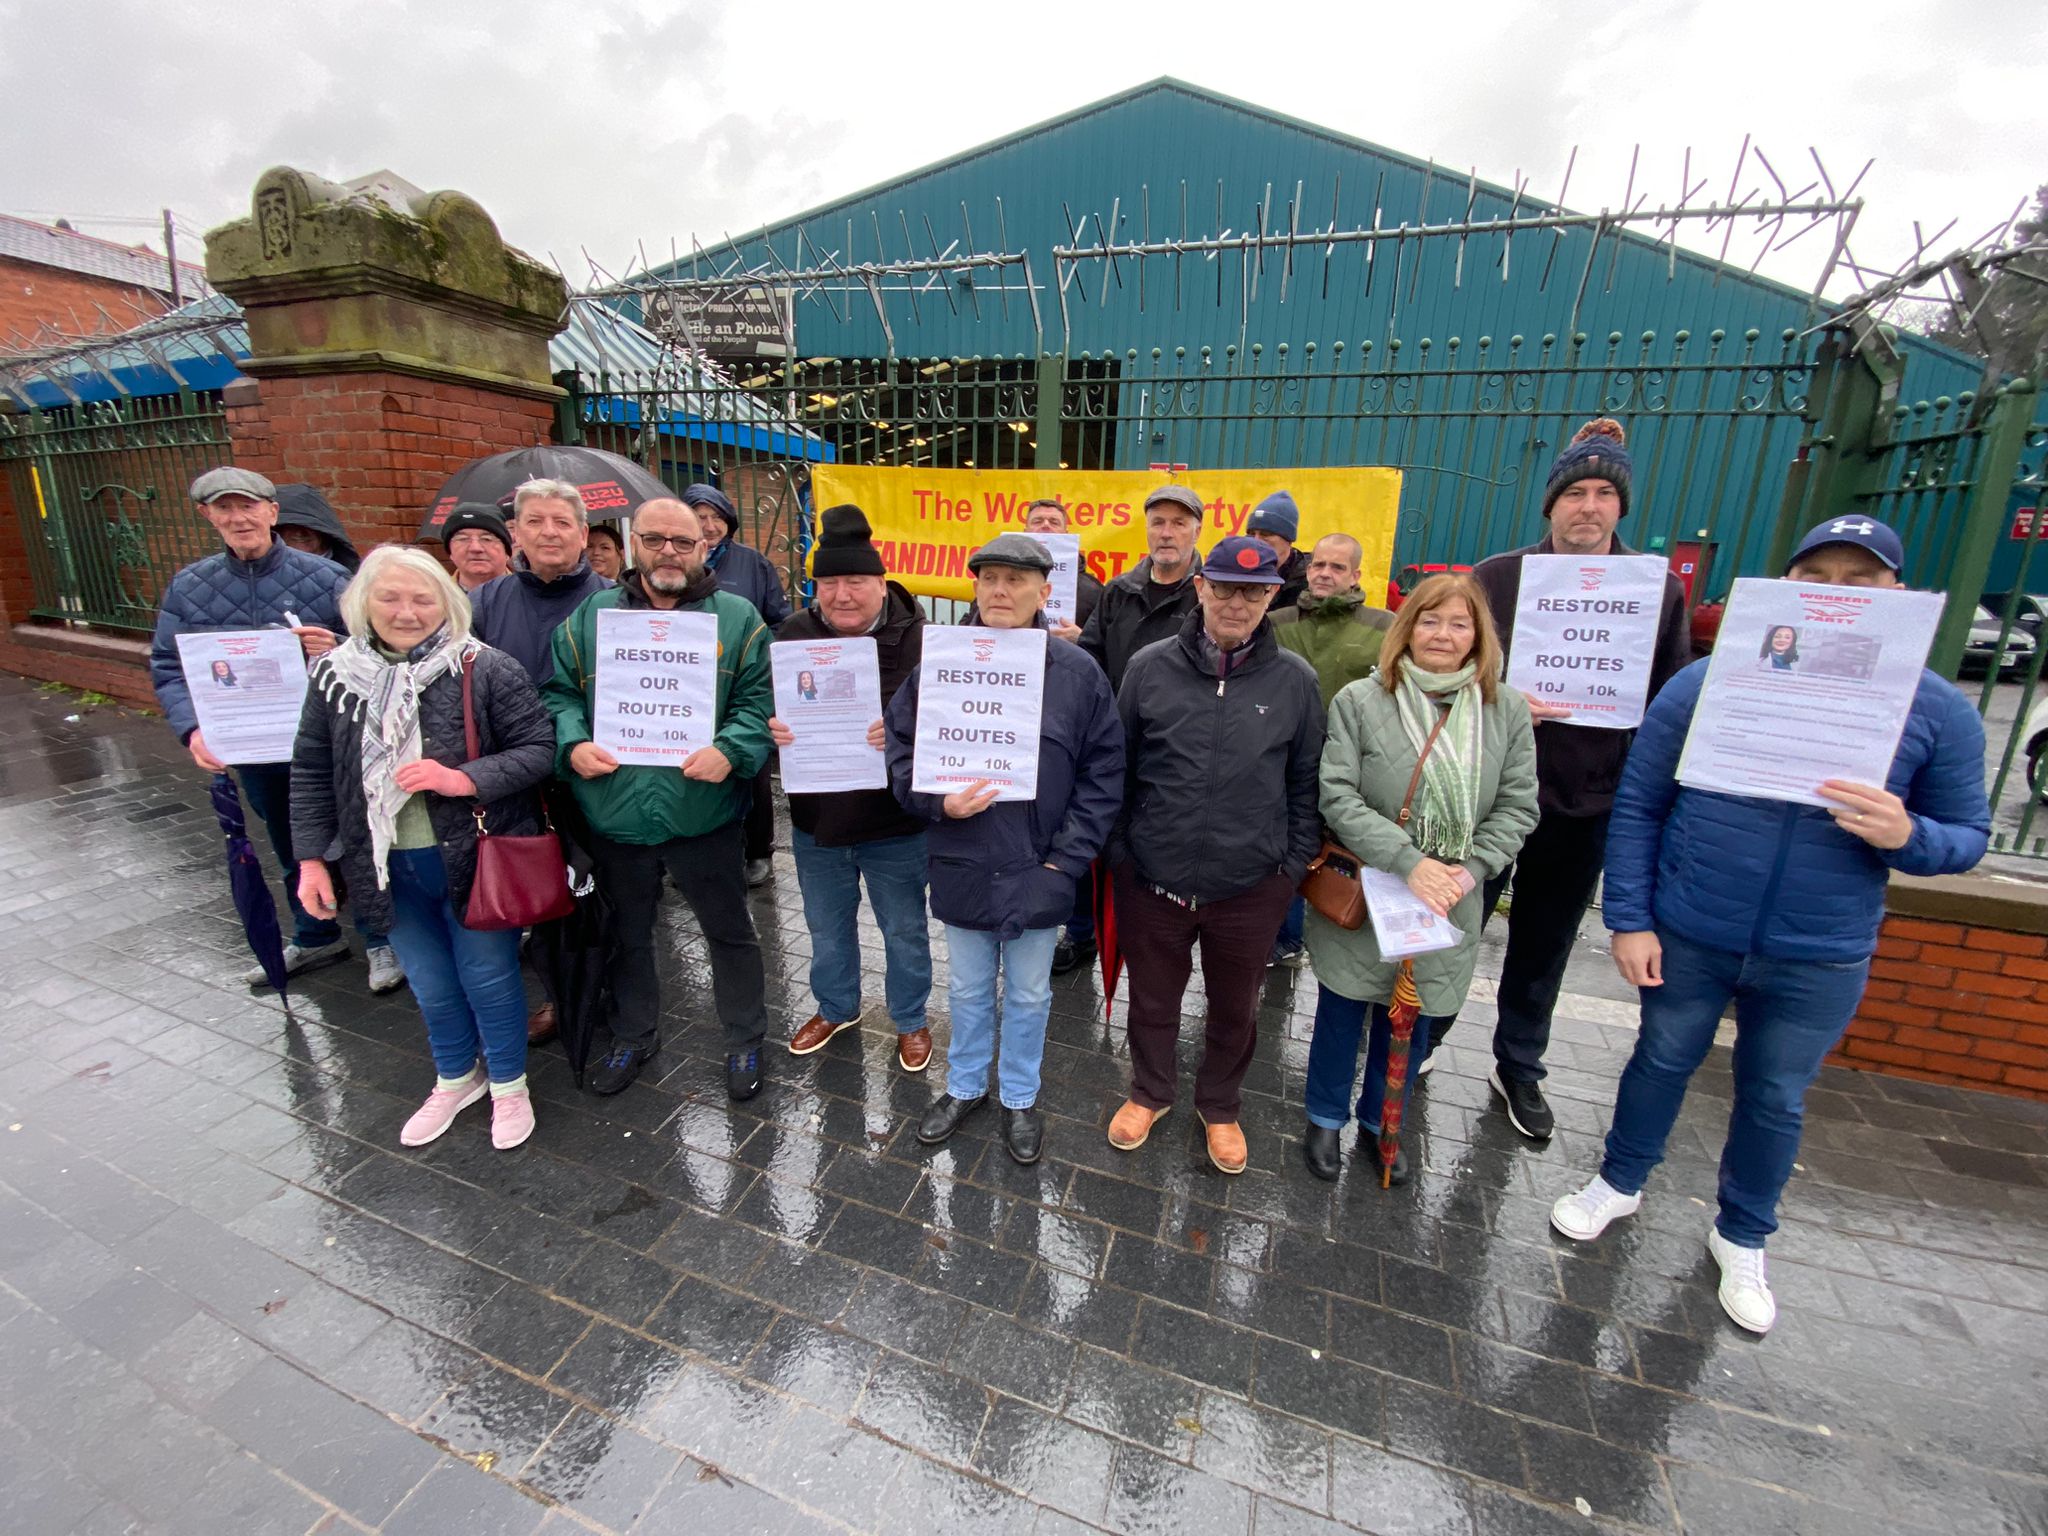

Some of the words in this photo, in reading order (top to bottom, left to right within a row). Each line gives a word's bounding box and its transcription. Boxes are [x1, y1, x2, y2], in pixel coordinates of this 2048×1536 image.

[715, 325, 732, 335] an
[735, 322, 785, 336] Phoba
[723, 336, 747, 344] People
[581, 487, 624, 501] SUZU
[586, 497, 629, 511] ODEO
[913, 490, 972, 522] The
[984, 492, 1131, 527] Wokers
[1799, 593, 1872, 604] WORKERS
[1537, 598, 1640, 614] RESTORE
[1043, 617, 1058, 625] 0k
[1805, 615, 1855, 624] PARTY
[1563, 628, 1610, 643] OUR
[615, 648, 700, 664] RESTORE
[1535, 655, 1624, 671] ROUTES
[640, 677, 679, 690] OUR
[937, 669, 1026, 687] RESTORE
[1535, 681, 1565, 693] 10J
[1587, 685, 1617, 697] 10k
[618, 702, 693, 717] ROUTES
[961, 701, 1003, 715] OUR
[619, 728, 644, 739] 10J
[663, 730, 688, 741] 10k
[938, 728, 1016, 744] ROUTES
[940, 756, 965, 767] 10J
[985, 758, 1012, 771] 10k
